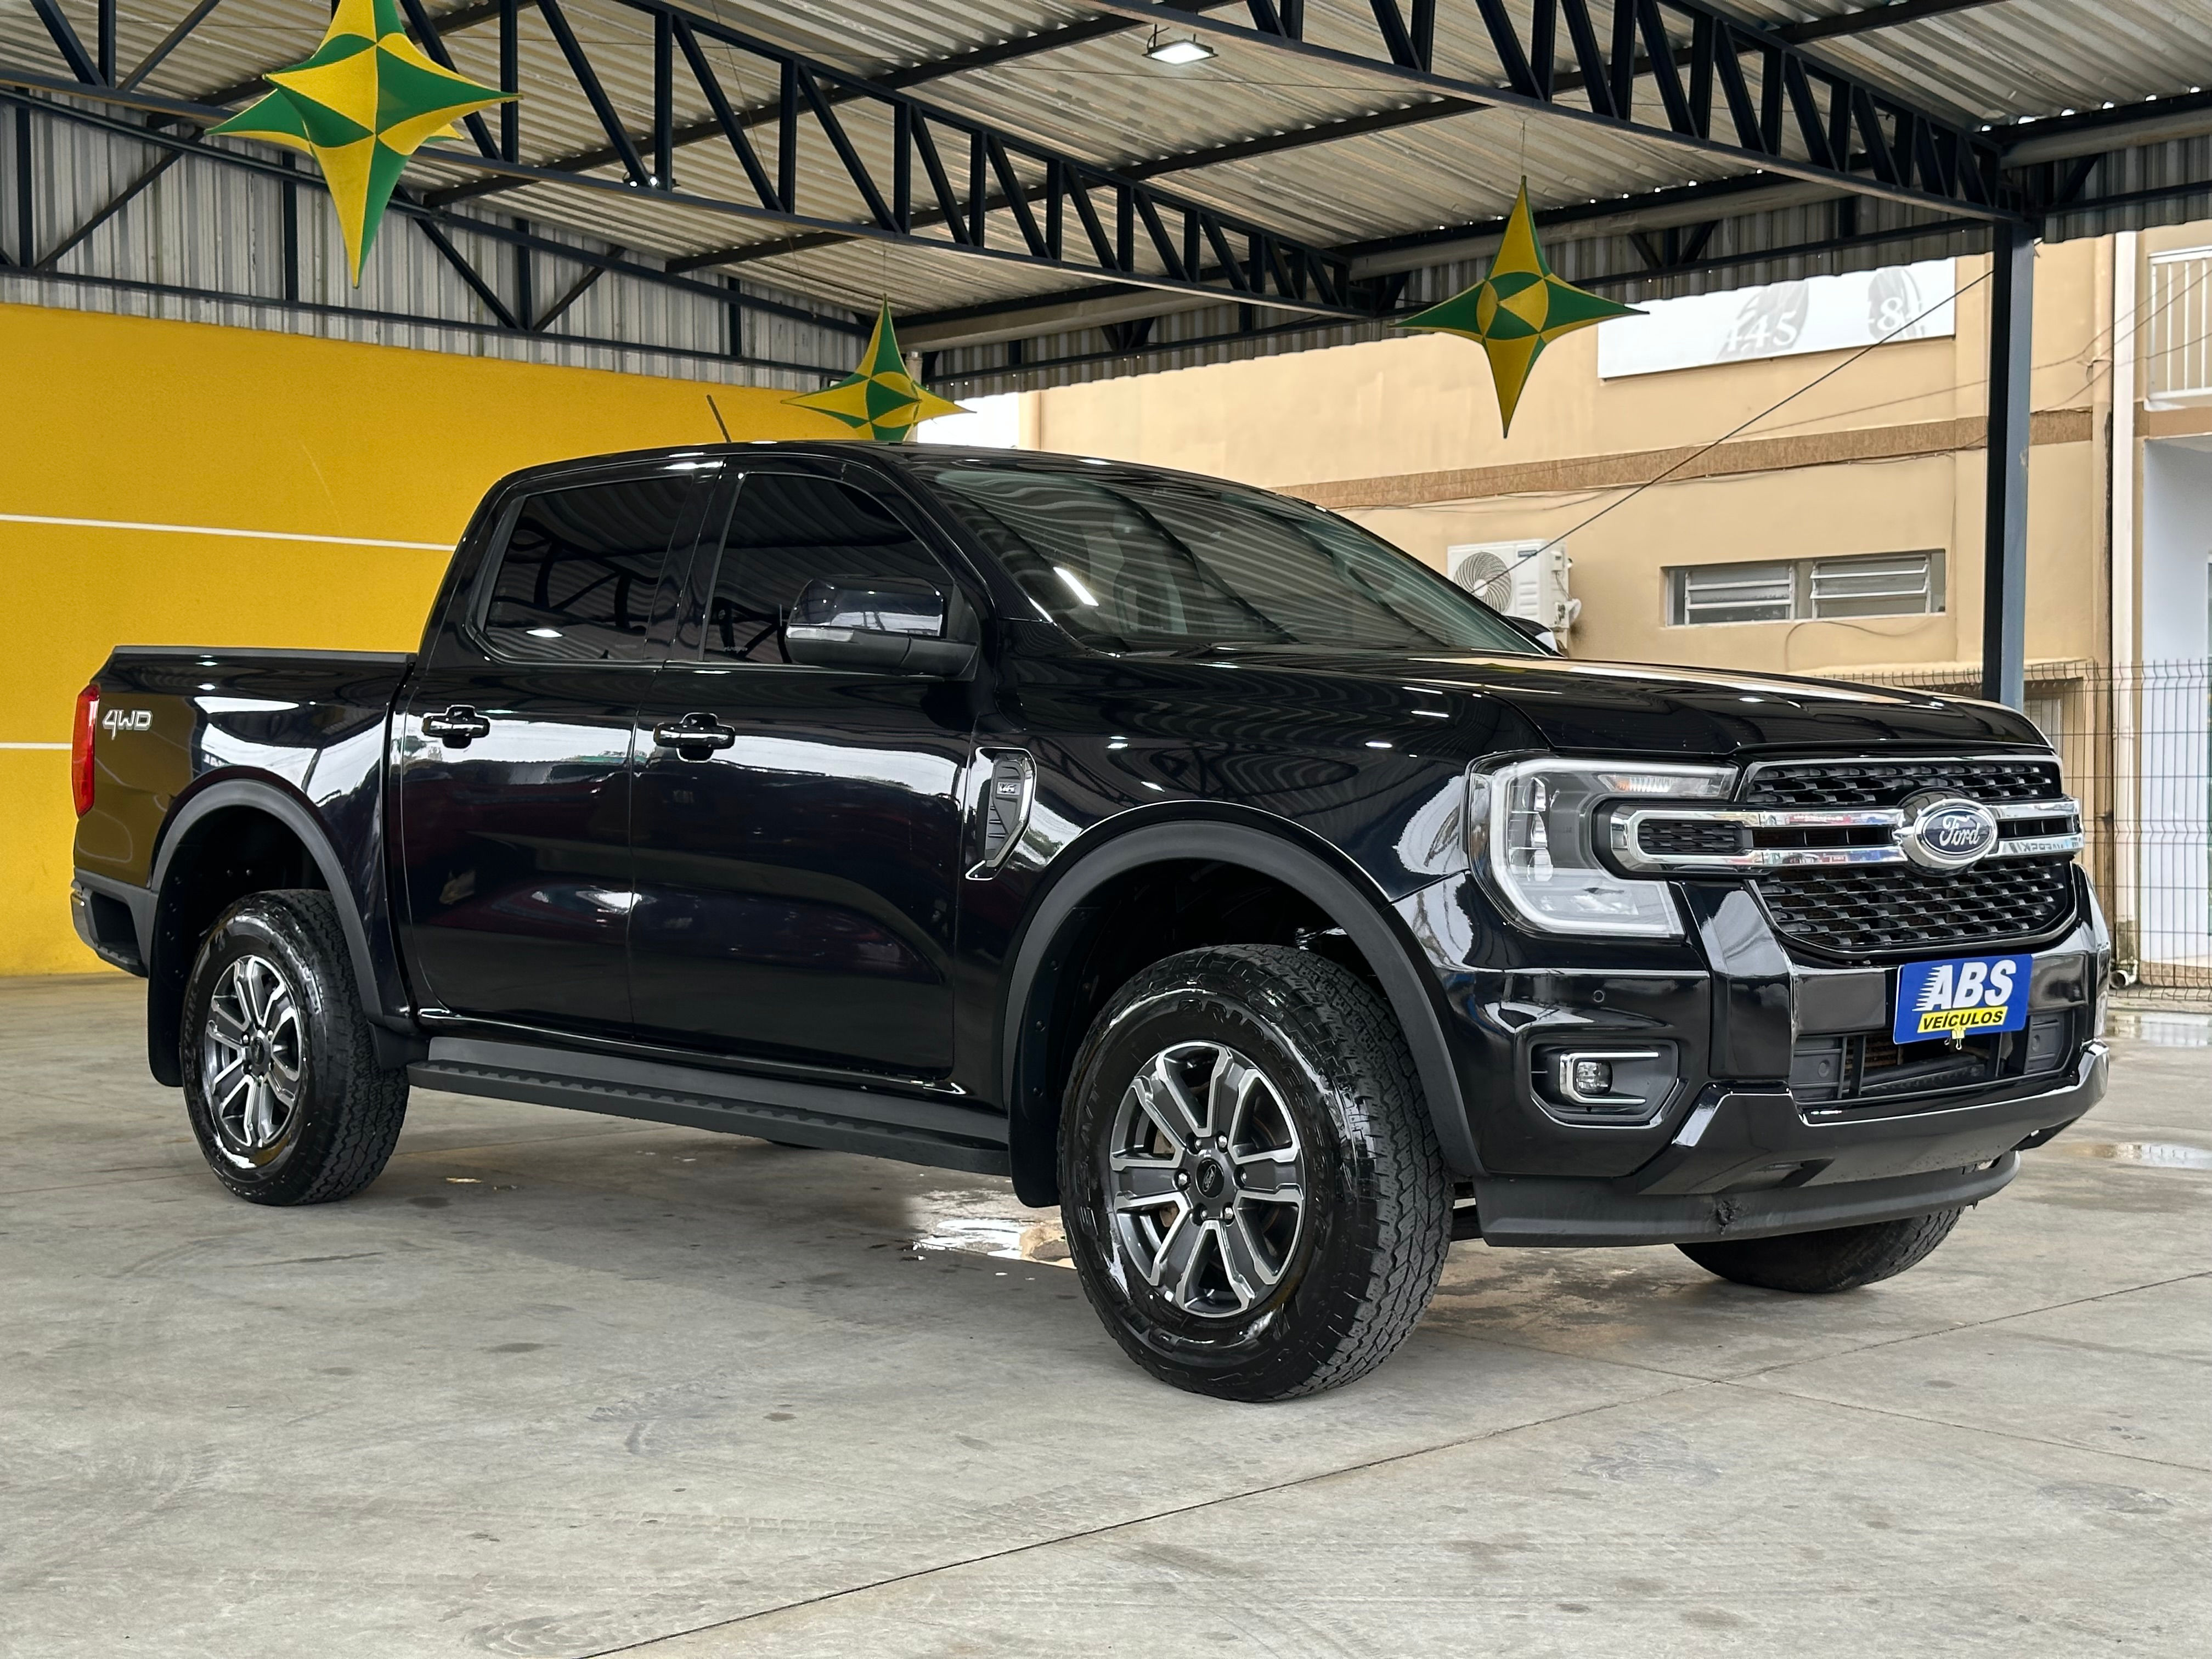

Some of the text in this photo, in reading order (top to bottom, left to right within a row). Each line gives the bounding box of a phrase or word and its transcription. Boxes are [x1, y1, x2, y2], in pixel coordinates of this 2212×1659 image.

[102, 709, 153, 740] 4WD
[1939, 815, 1980, 847] Ford
[1912, 959, 2017, 1012] ABS
[1922, 1010, 2004, 1030] VEÍCULOS
[1177, 998, 1329, 1250] BRIDGESTONE
